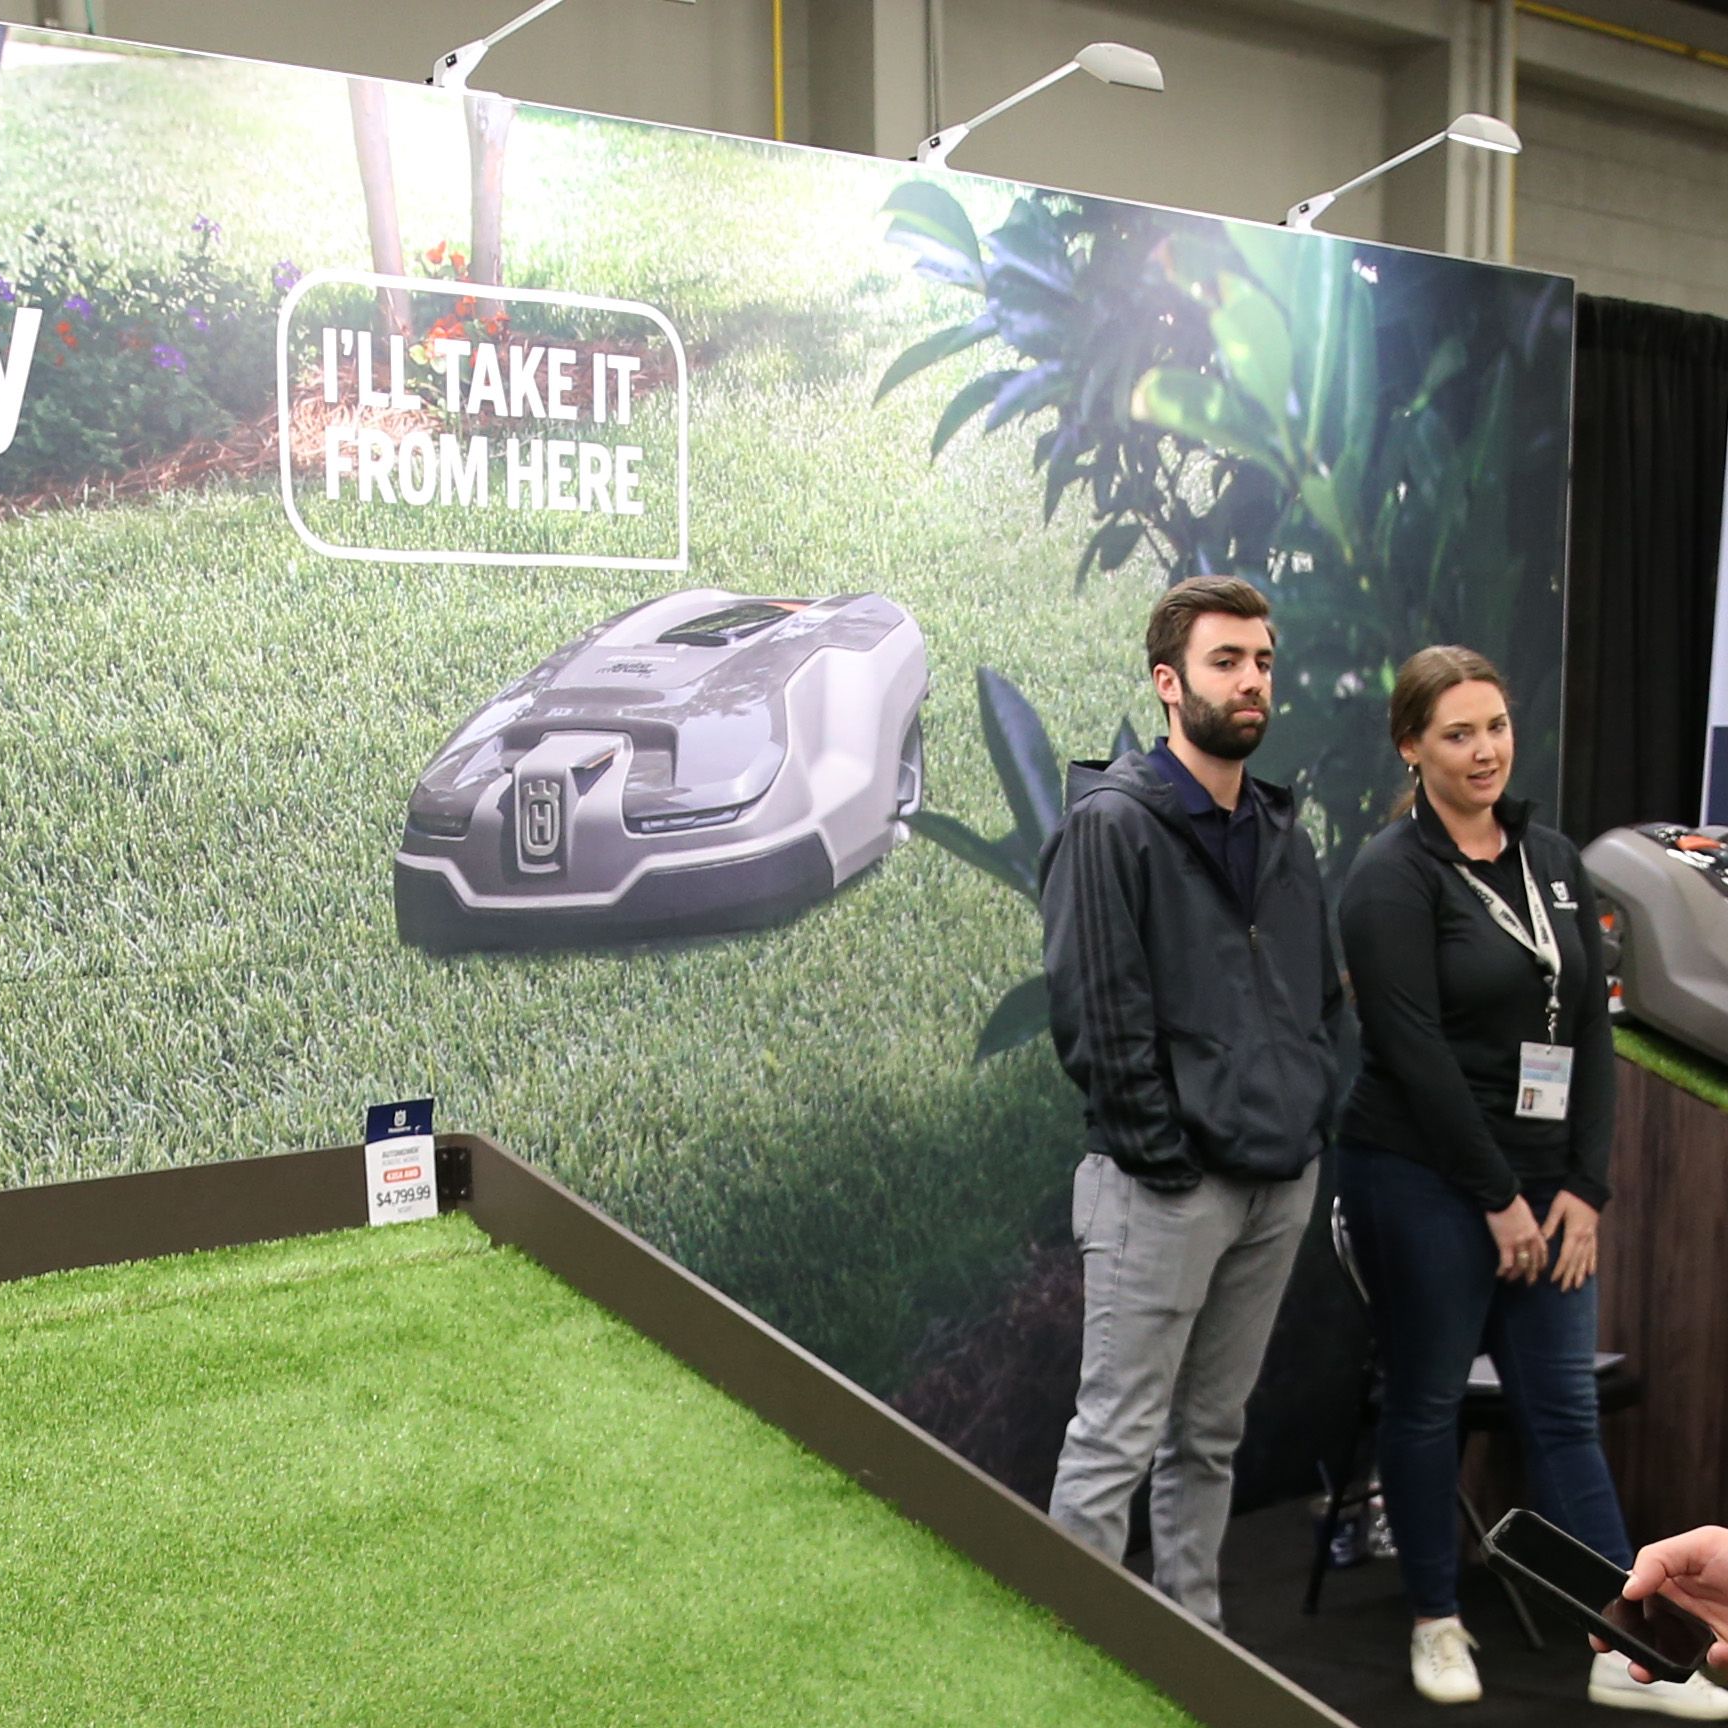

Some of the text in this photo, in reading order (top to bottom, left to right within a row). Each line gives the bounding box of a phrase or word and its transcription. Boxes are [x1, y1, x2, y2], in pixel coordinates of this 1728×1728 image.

[322, 328, 641, 425] I'LL TAKE IT
[325, 425, 644, 515] FROM HERE
